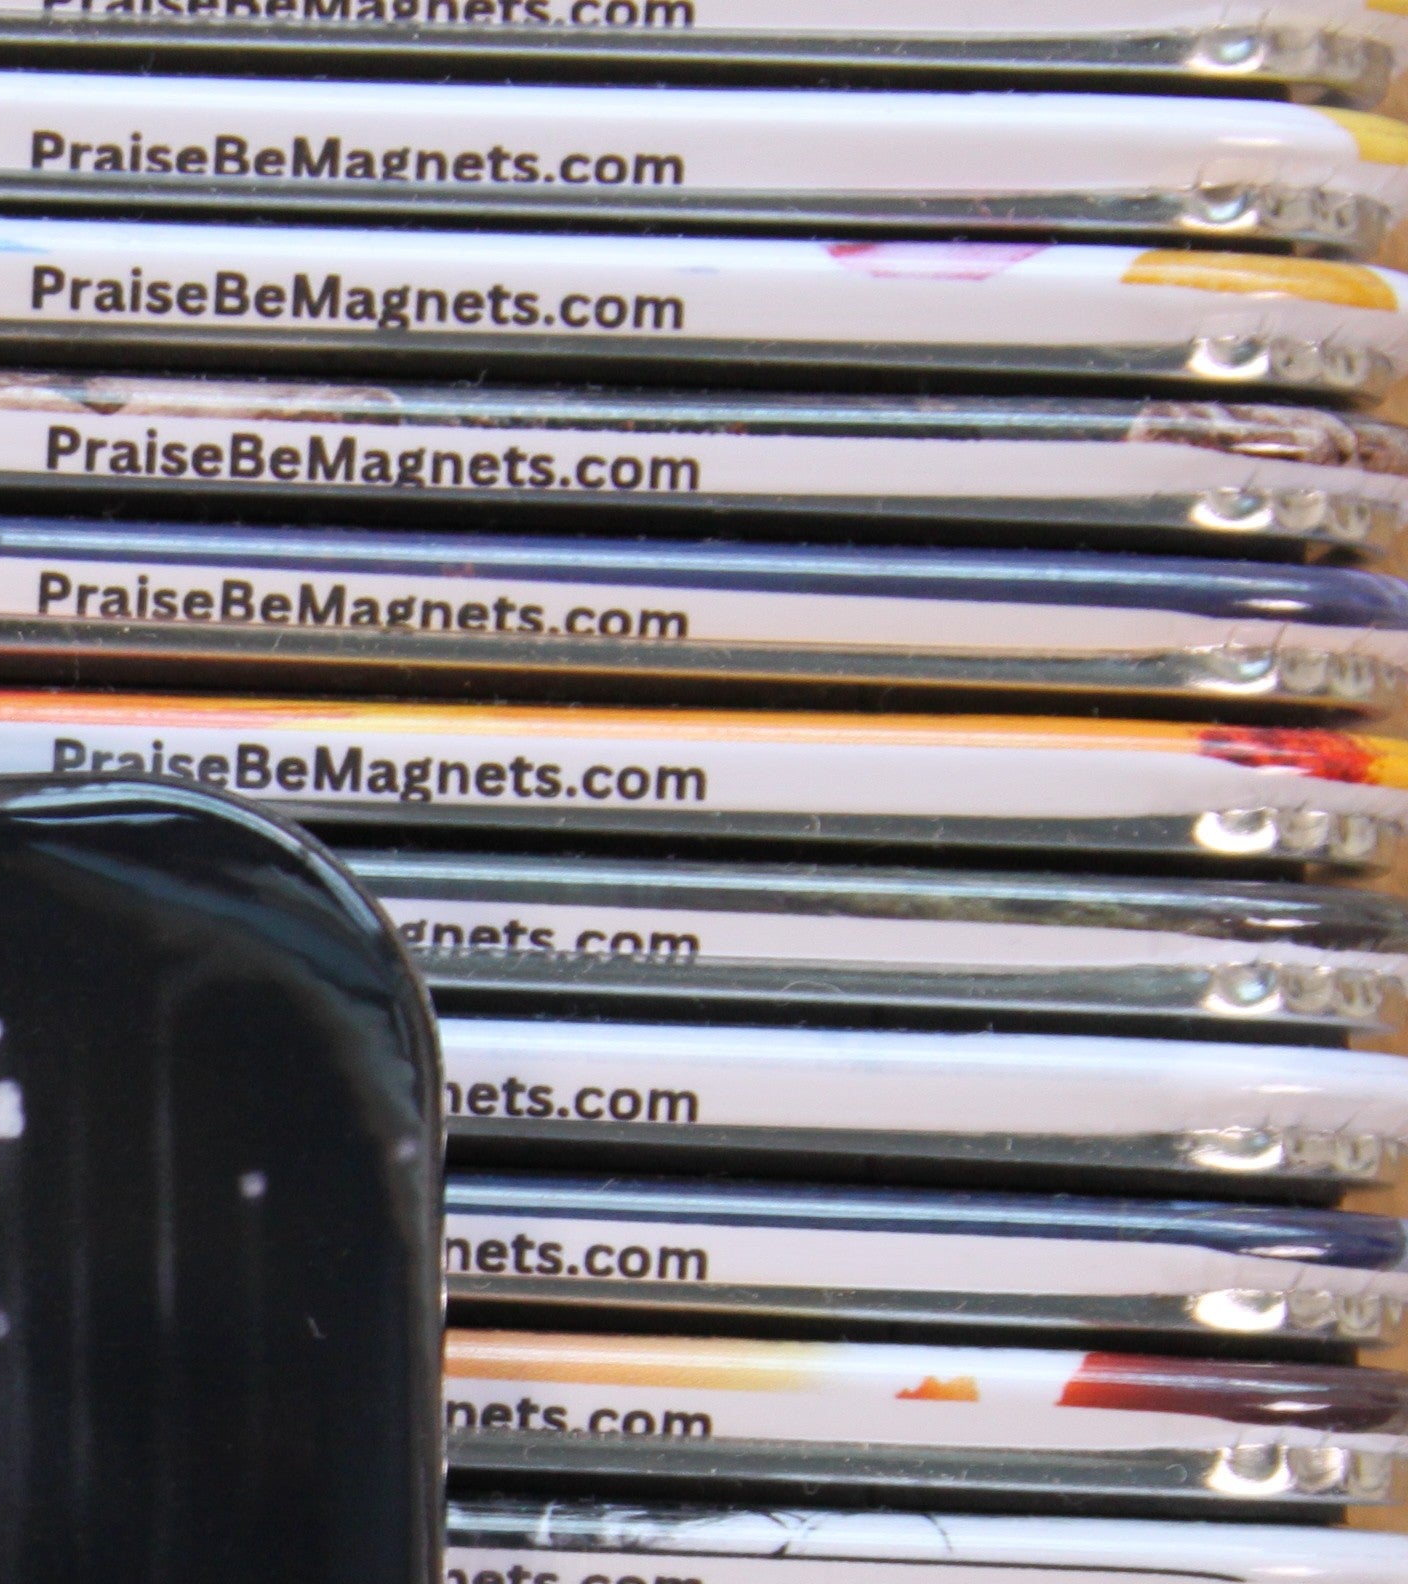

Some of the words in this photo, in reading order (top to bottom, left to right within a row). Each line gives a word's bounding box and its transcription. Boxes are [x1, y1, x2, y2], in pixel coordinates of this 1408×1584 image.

[31, 131, 684, 185] PraiseBeMagnets.com
[31, 265, 684, 331] PraiseBeMagnets.com
[46, 425, 700, 490] PraiseBeMagnets.com
[38, 571, 689, 638] PraiseBeMagnets.com
[52, 737, 707, 802] PraiseBeMagnets.com
[398, 919, 701, 955] gnetscom
